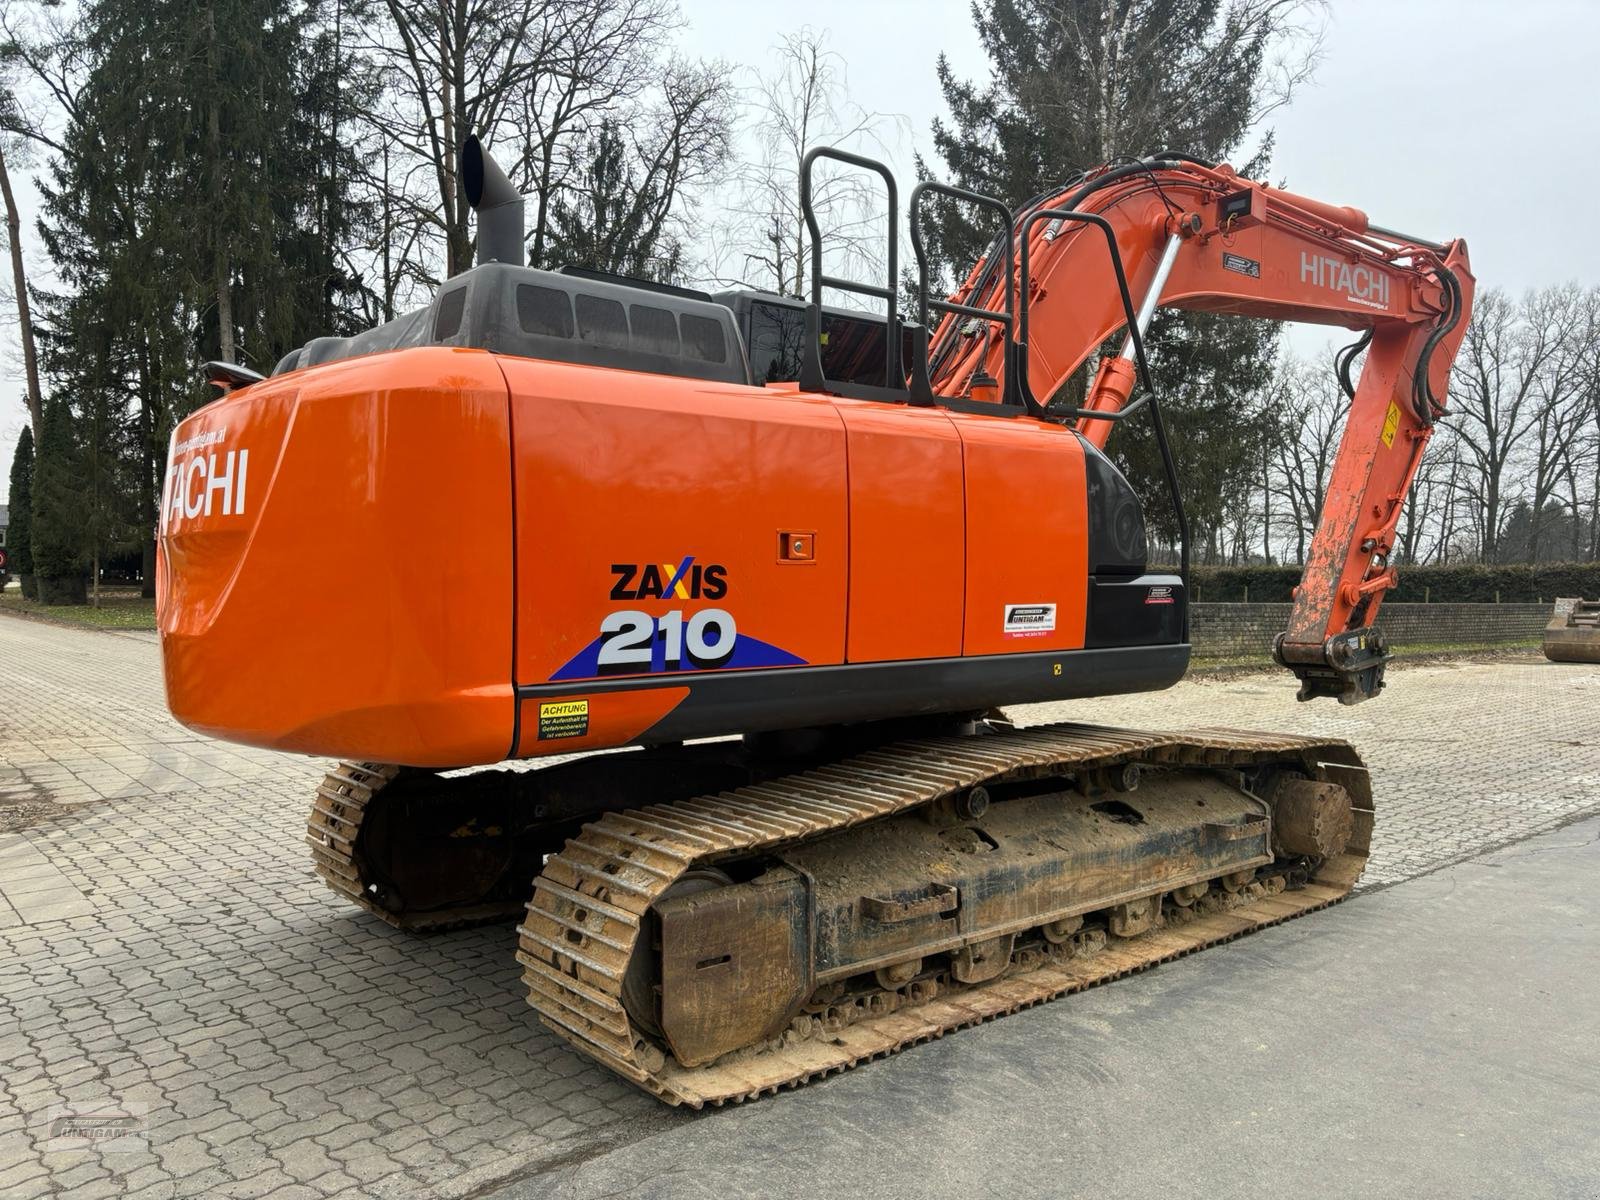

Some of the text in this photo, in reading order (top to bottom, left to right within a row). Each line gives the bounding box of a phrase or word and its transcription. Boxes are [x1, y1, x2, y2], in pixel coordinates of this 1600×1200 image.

[1301, 251, 1389, 304] HITACHI
[609, 556, 728, 600] ZAXIS
[597, 608, 737, 668] 210
[542, 723, 587, 732] Gefahrenbereich
[543, 704, 586, 715] ACHTUNG
